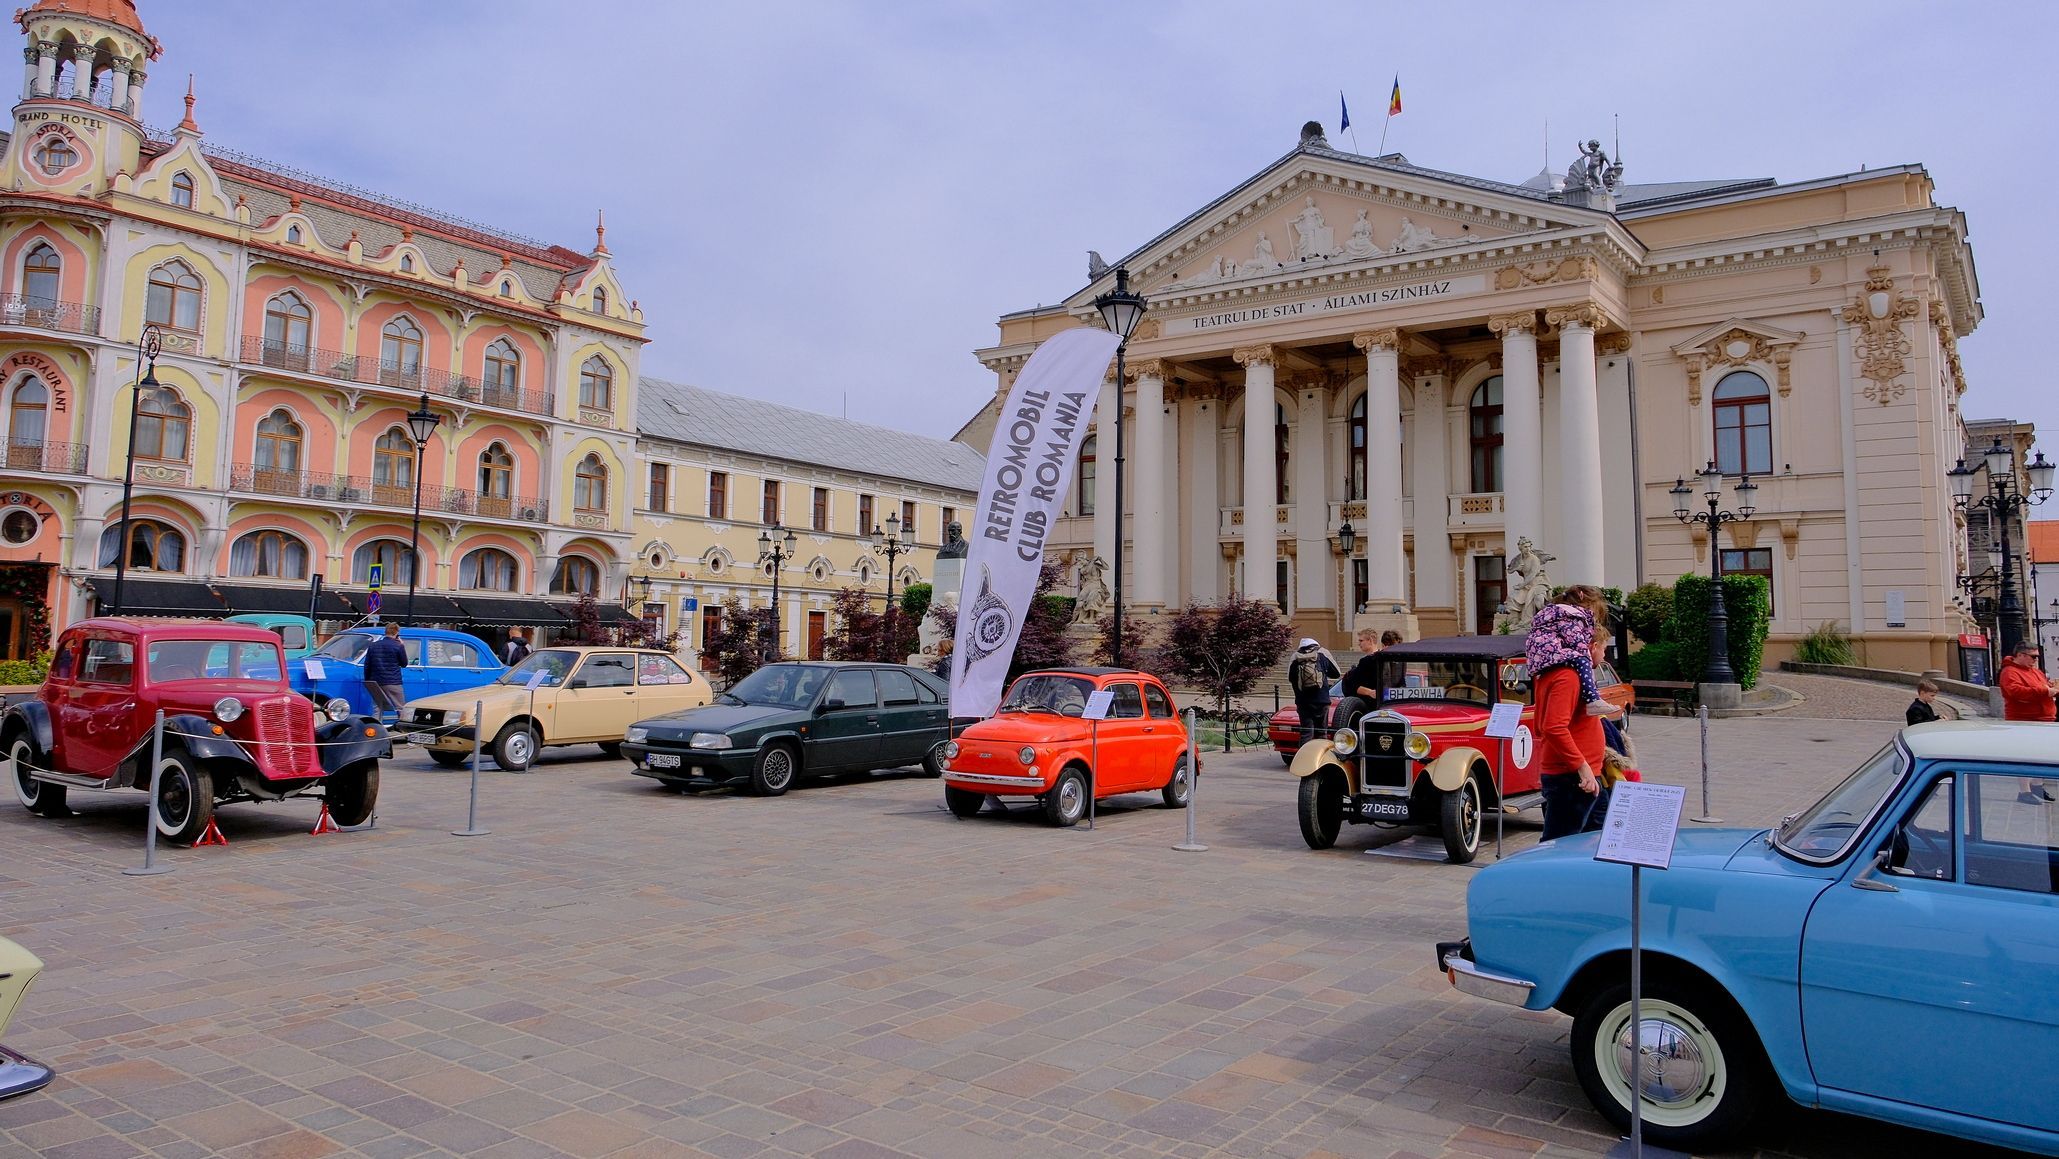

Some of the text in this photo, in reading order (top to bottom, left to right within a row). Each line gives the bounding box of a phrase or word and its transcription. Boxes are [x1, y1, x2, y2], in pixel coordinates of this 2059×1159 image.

[19, 112, 102, 129] GRAND HOTEL
[36, 124, 76, 142] ASTORIA
[1192, 281, 1451, 329] TEATRUL DE STAT ÁLLAMI SZÍNHÁZ
[11, 355, 67, 413] RESTAURANT
[984, 390, 1051, 542] RETROMOBIL
[1017, 392, 1087, 562] CLUB ROMANIA
[1390, 688, 1443, 700] BH 29WHA
[1520, 737, 1526, 758] 1
